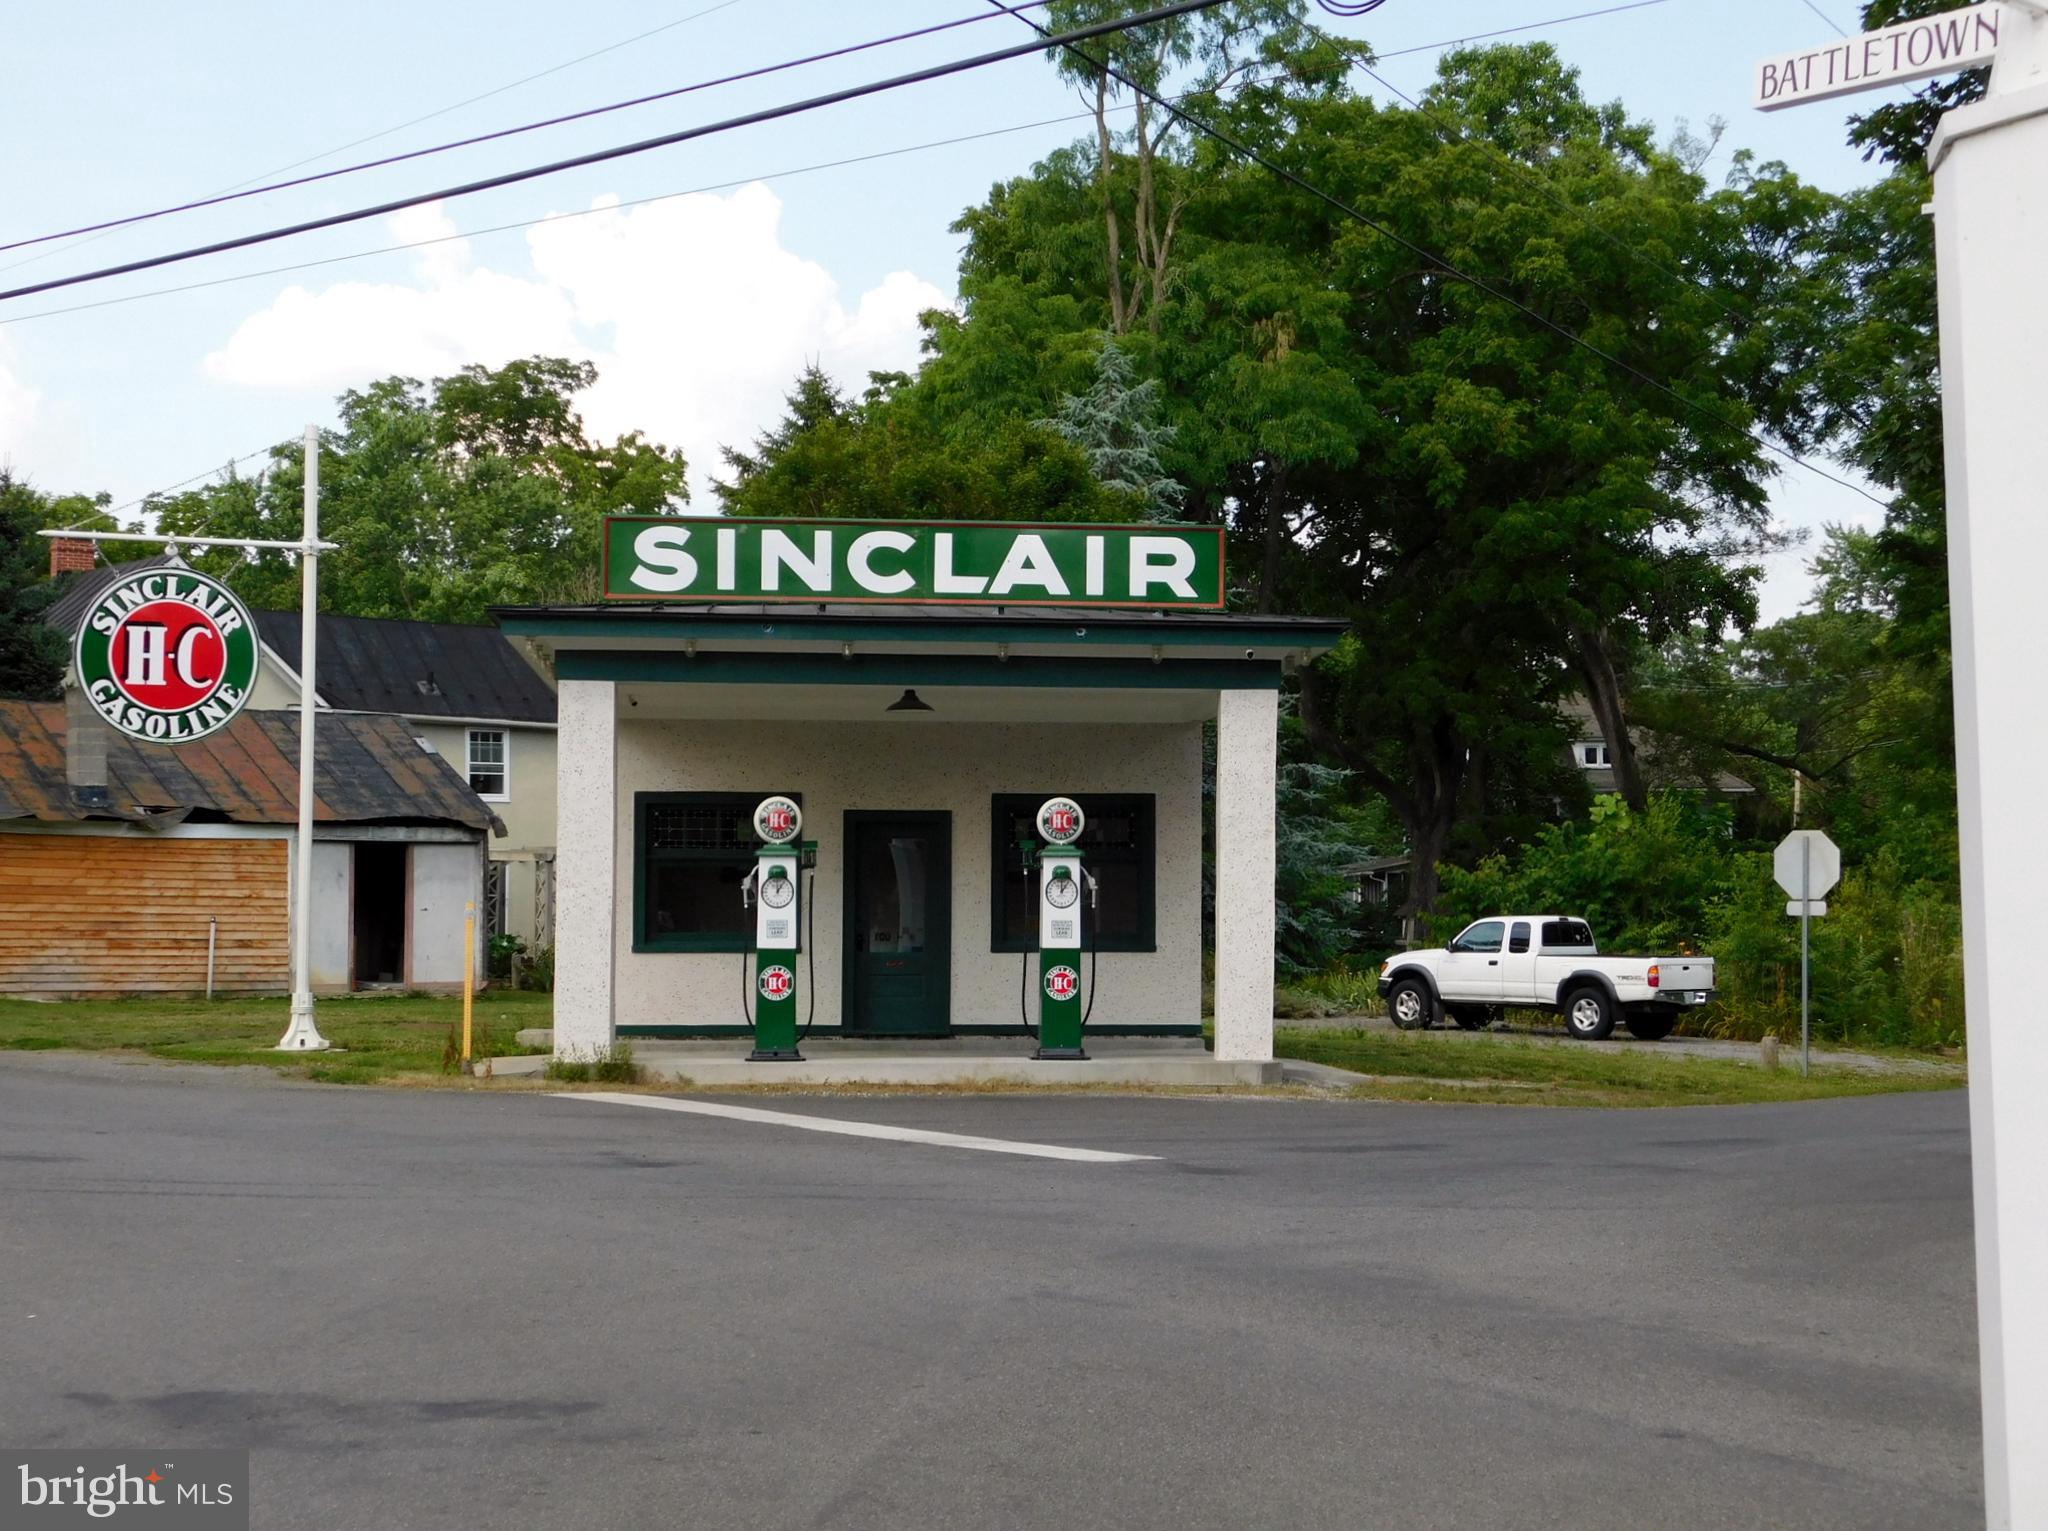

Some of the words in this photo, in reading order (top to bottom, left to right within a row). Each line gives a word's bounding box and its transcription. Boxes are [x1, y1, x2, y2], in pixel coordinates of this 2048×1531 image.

[1760, 8, 2000, 100] BATTLETOWN
[629, 525, 1199, 598] SINCLAIR
[91, 575, 243, 638] SINCLAIR
[90, 678, 244, 739] GASOLINE
